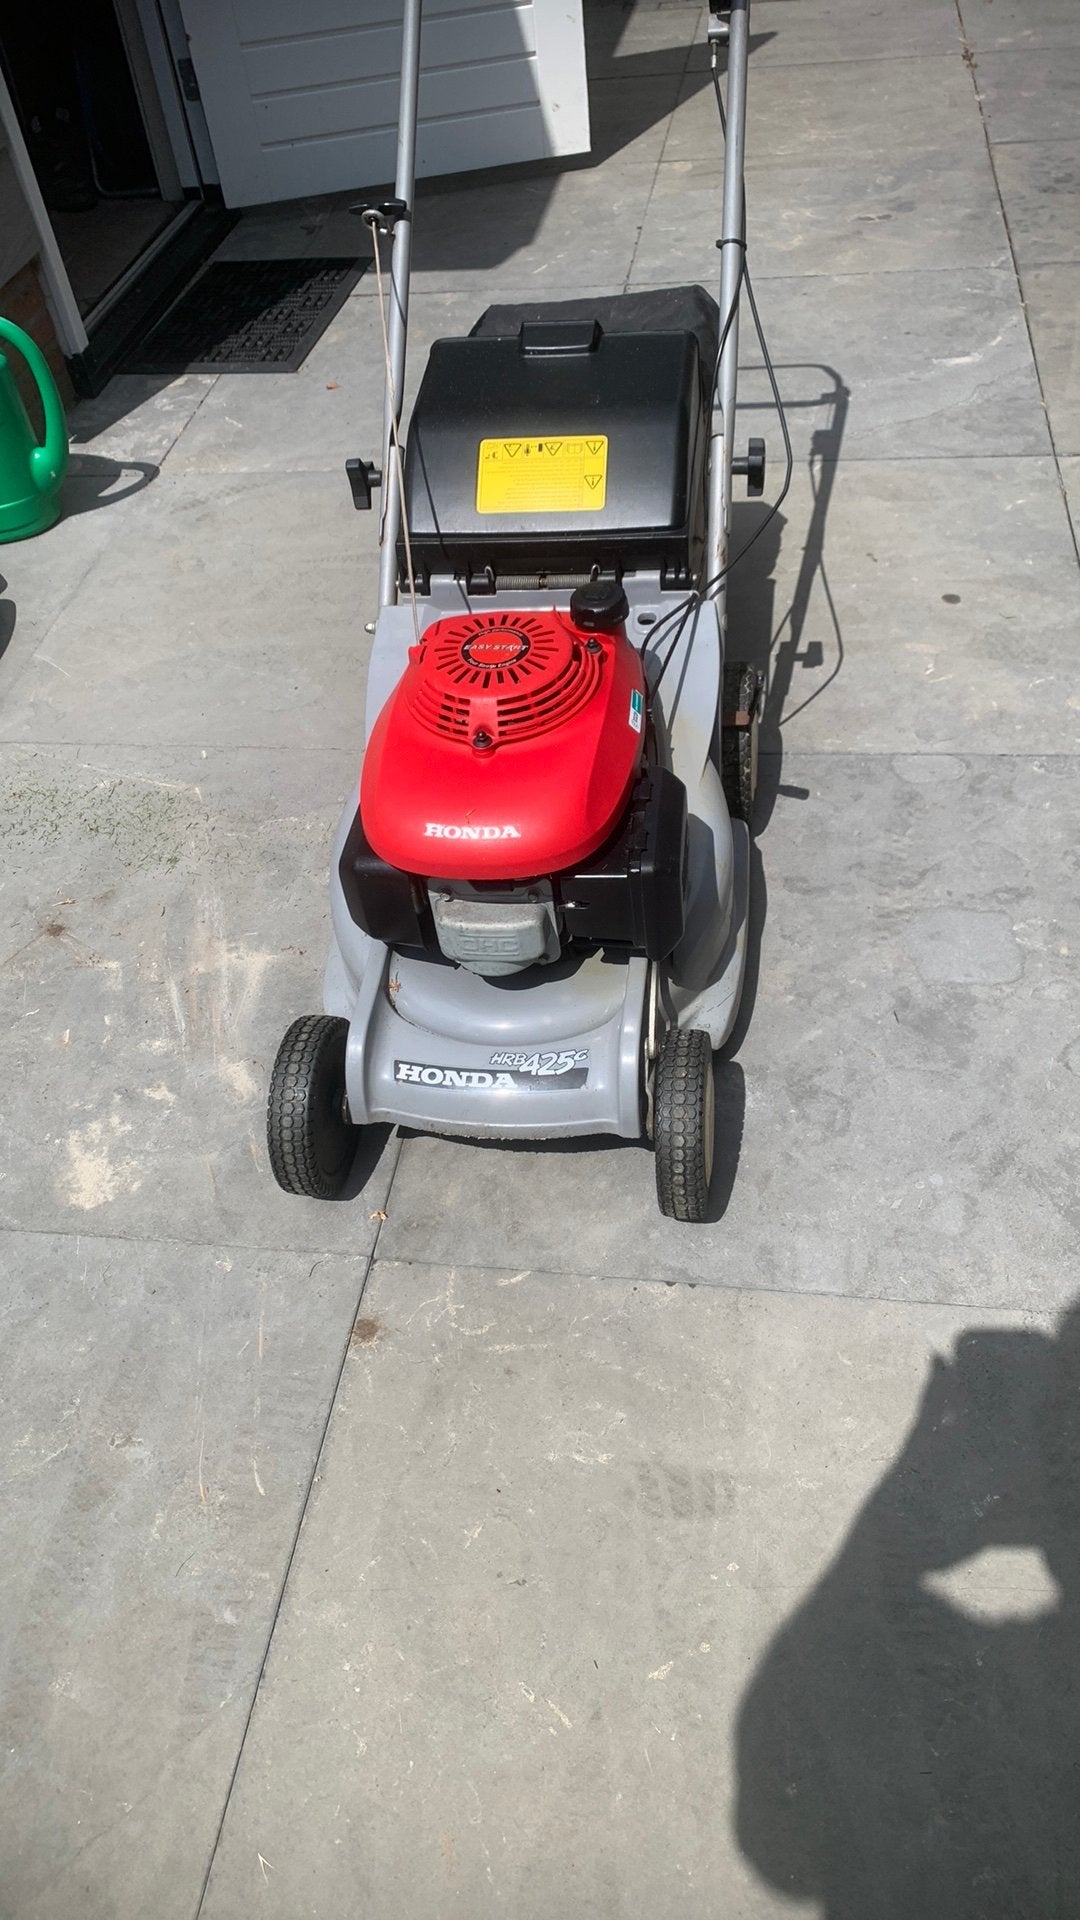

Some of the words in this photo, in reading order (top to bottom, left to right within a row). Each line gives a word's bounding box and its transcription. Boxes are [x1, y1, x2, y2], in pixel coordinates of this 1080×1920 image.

[463, 643, 493, 651] EASY
[493, 643, 529, 652] START
[424, 822, 521, 840] HONDA
[396, 1063, 518, 1089] HONDA
